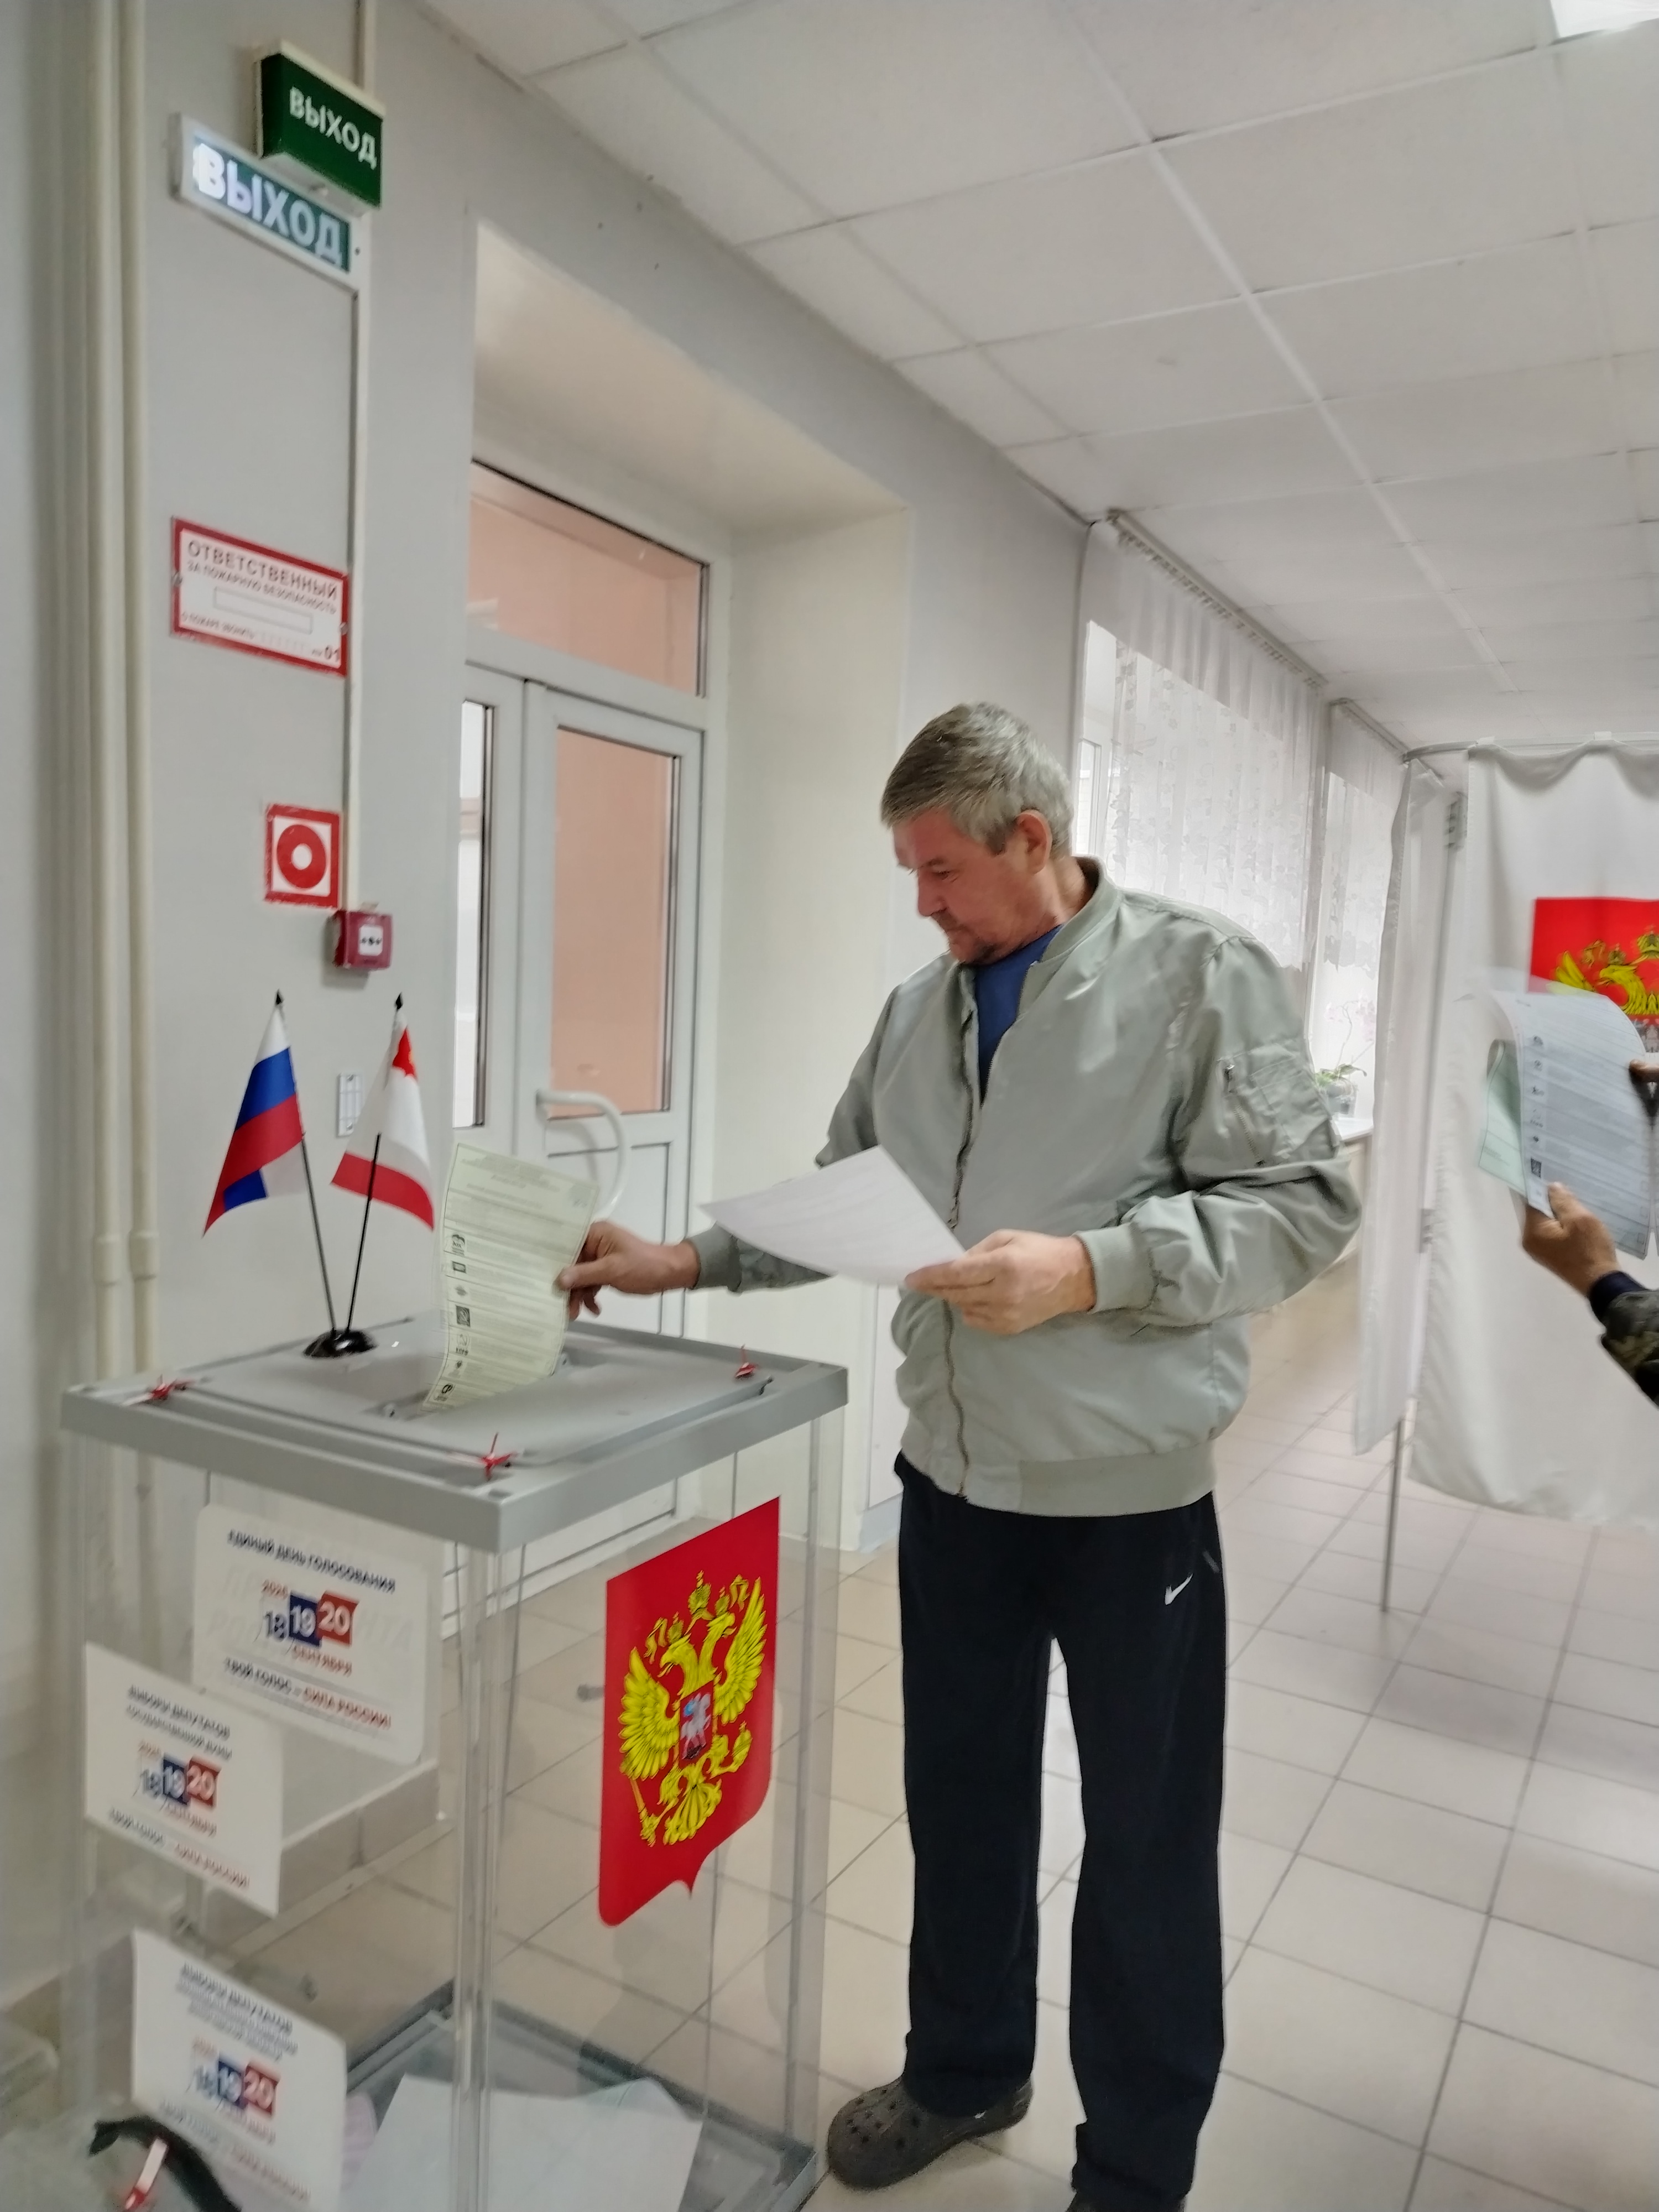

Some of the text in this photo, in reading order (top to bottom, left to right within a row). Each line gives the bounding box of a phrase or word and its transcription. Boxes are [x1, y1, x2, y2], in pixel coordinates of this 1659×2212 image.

[289, 86, 377, 170] ВЫХОД
[192, 142, 342, 268] ВЫХОД
[188, 540, 337, 601] ОТВЕТСТВЕННЫЙ
[324, 645, 341, 662] 01
[227, 1529, 396, 1595] ЕДИНЫЙ ДЕНЬ ГОЛОСОВАНИЯ
[264, 1610, 288, 1642] 18
[290, 1604, 316, 1637] 19
[318, 1601, 351, 1636] 20
[225, 1657, 254, 1680] ТВОЙ
[254, 1668, 292, 1695] ГОЛОС
[304, 1687, 335, 1710] СИЛА
[186, 1765, 216, 1801] 20
[243, 2070, 275, 2109] 20
